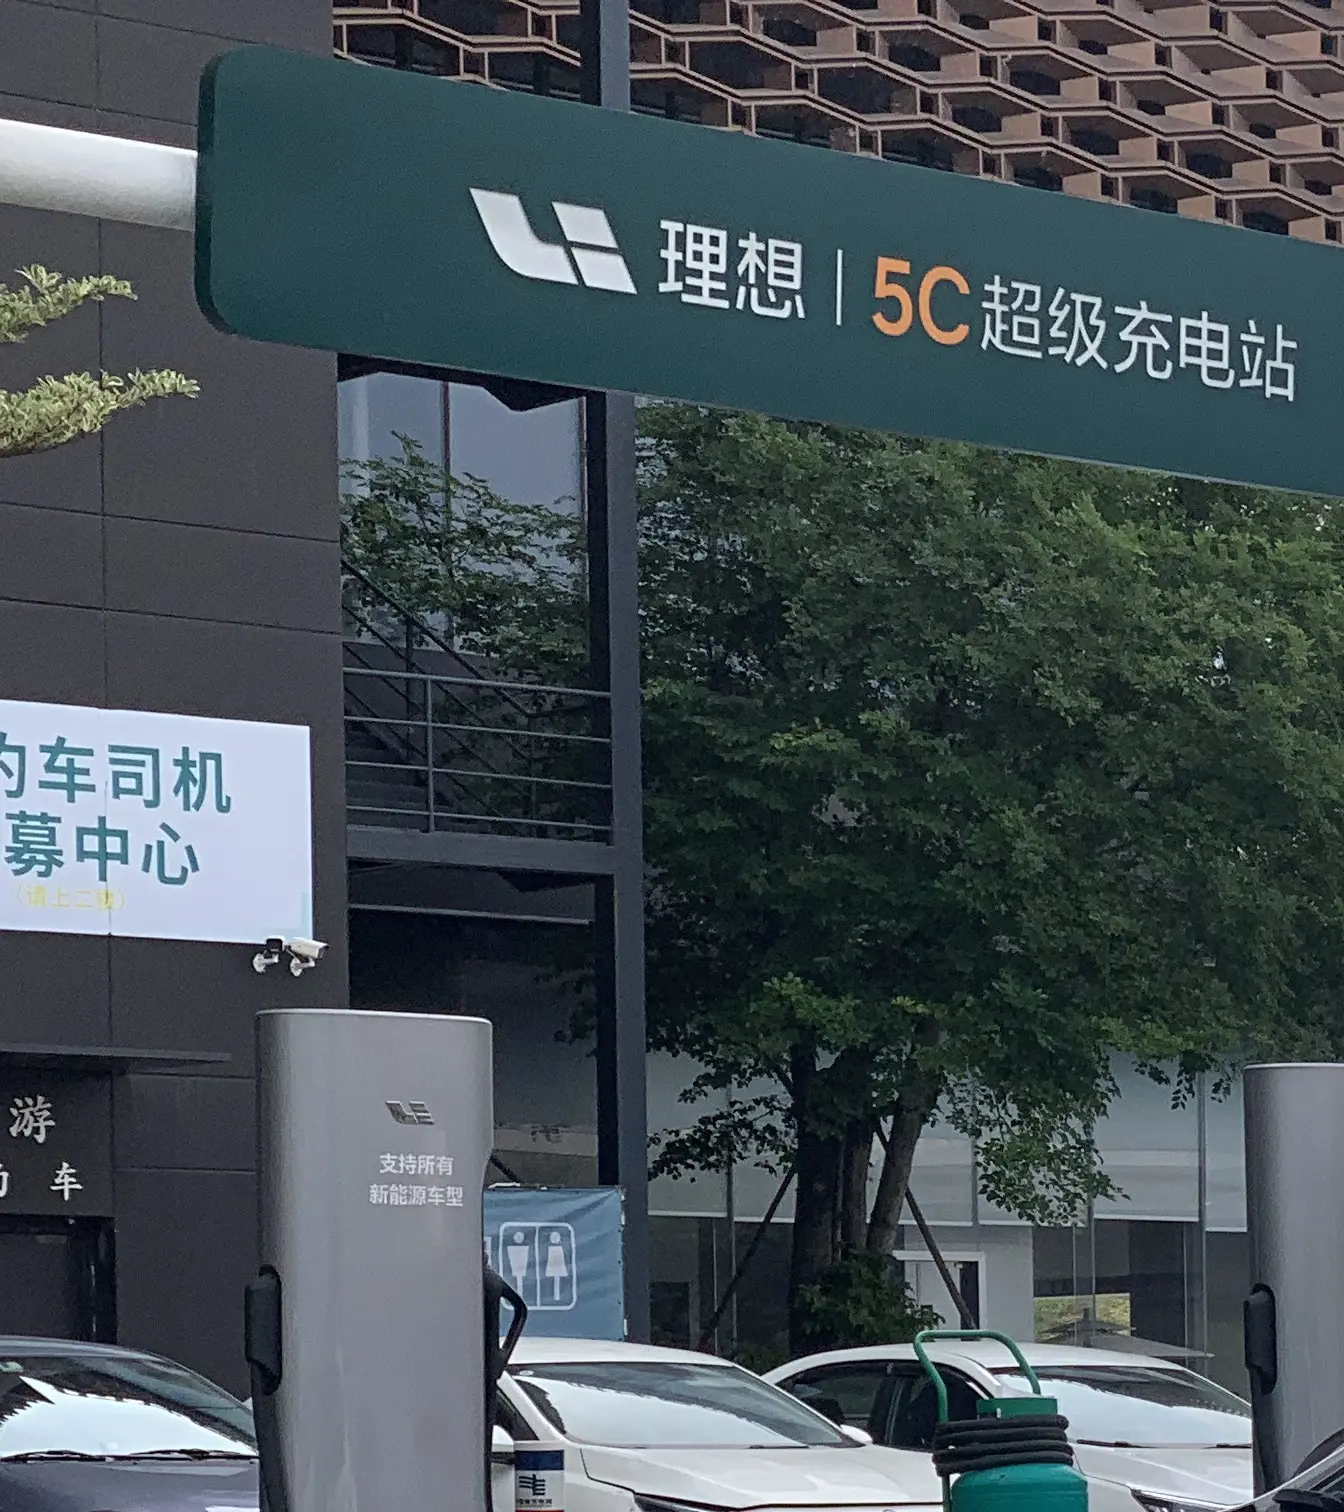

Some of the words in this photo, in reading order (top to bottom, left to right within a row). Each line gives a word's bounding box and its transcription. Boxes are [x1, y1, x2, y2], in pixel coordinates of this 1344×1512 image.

[658, 219, 807, 320] 理想
[872, 255, 1299, 402] 5C超级充电站
[5, 810, 200, 886] 募中心
[9, 1095, 56, 1144] 游
[379, 1153, 454, 1176] 支持所有
[369, 1184, 464, 1207] 新能源车型
